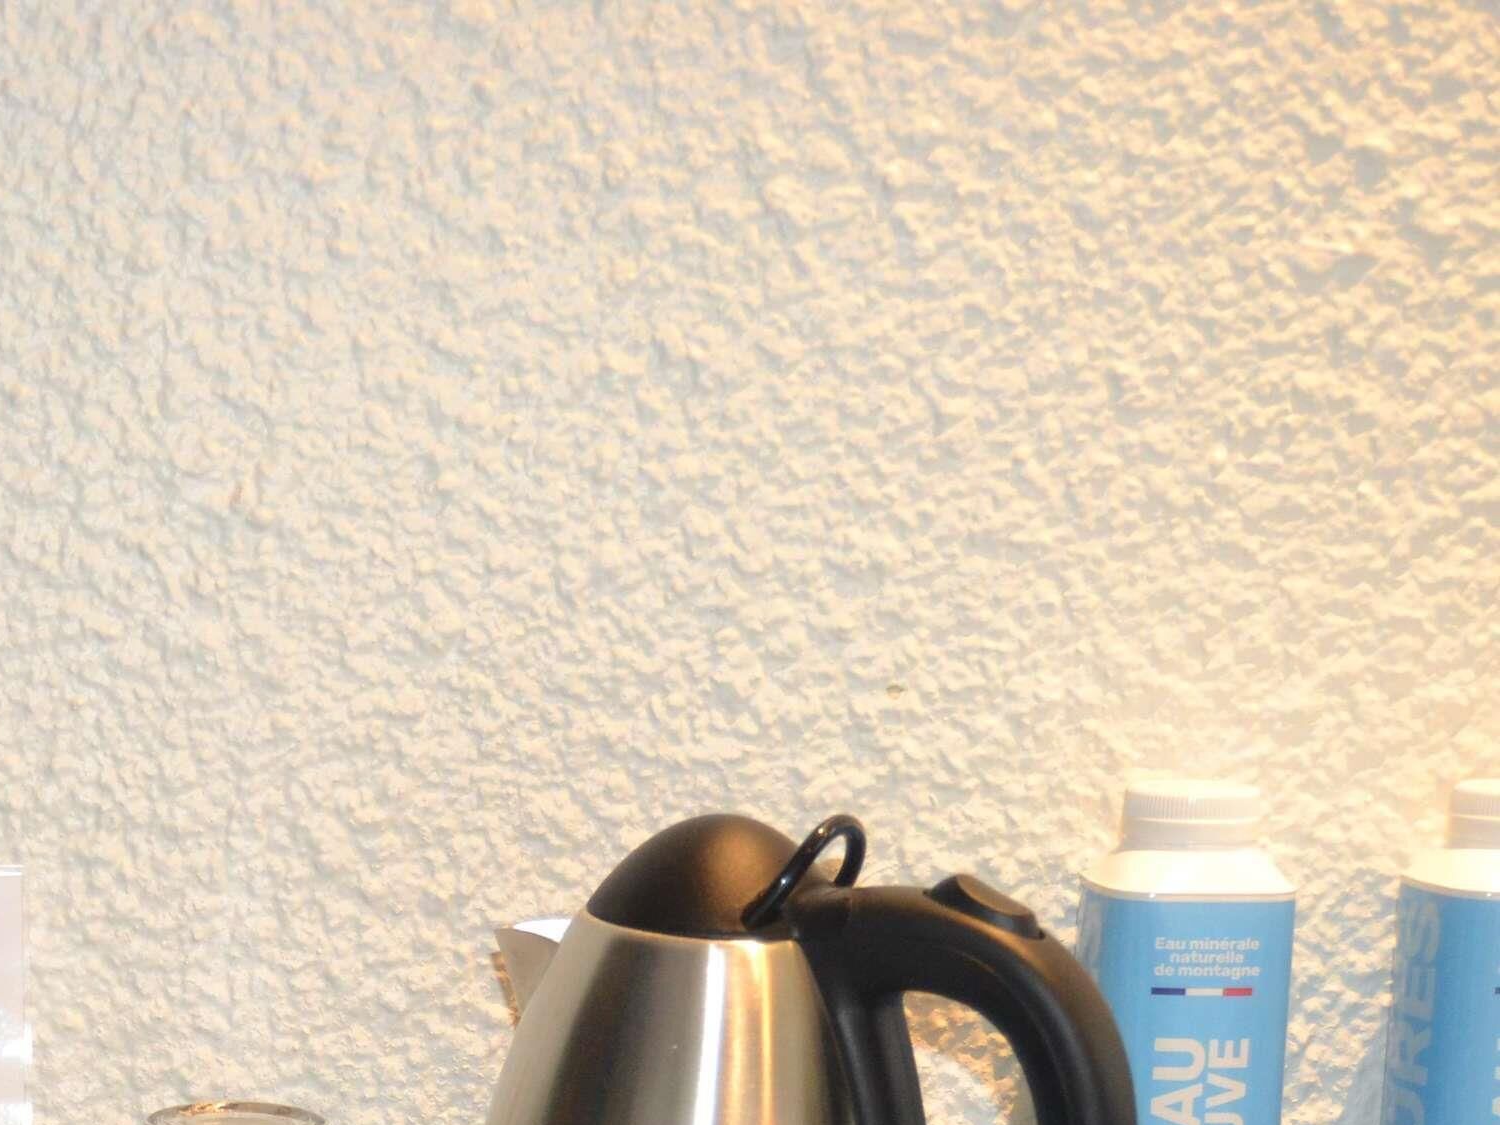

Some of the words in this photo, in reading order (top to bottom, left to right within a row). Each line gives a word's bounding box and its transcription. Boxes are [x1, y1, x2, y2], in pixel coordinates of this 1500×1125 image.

[1155, 937, 1186, 950] Eau
[1190, 936, 1261, 951] minérale
[1170, 951, 1244, 964] naturelle
[1154, 964, 1175, 976] de
[1178, 964, 1261, 980] montagne
